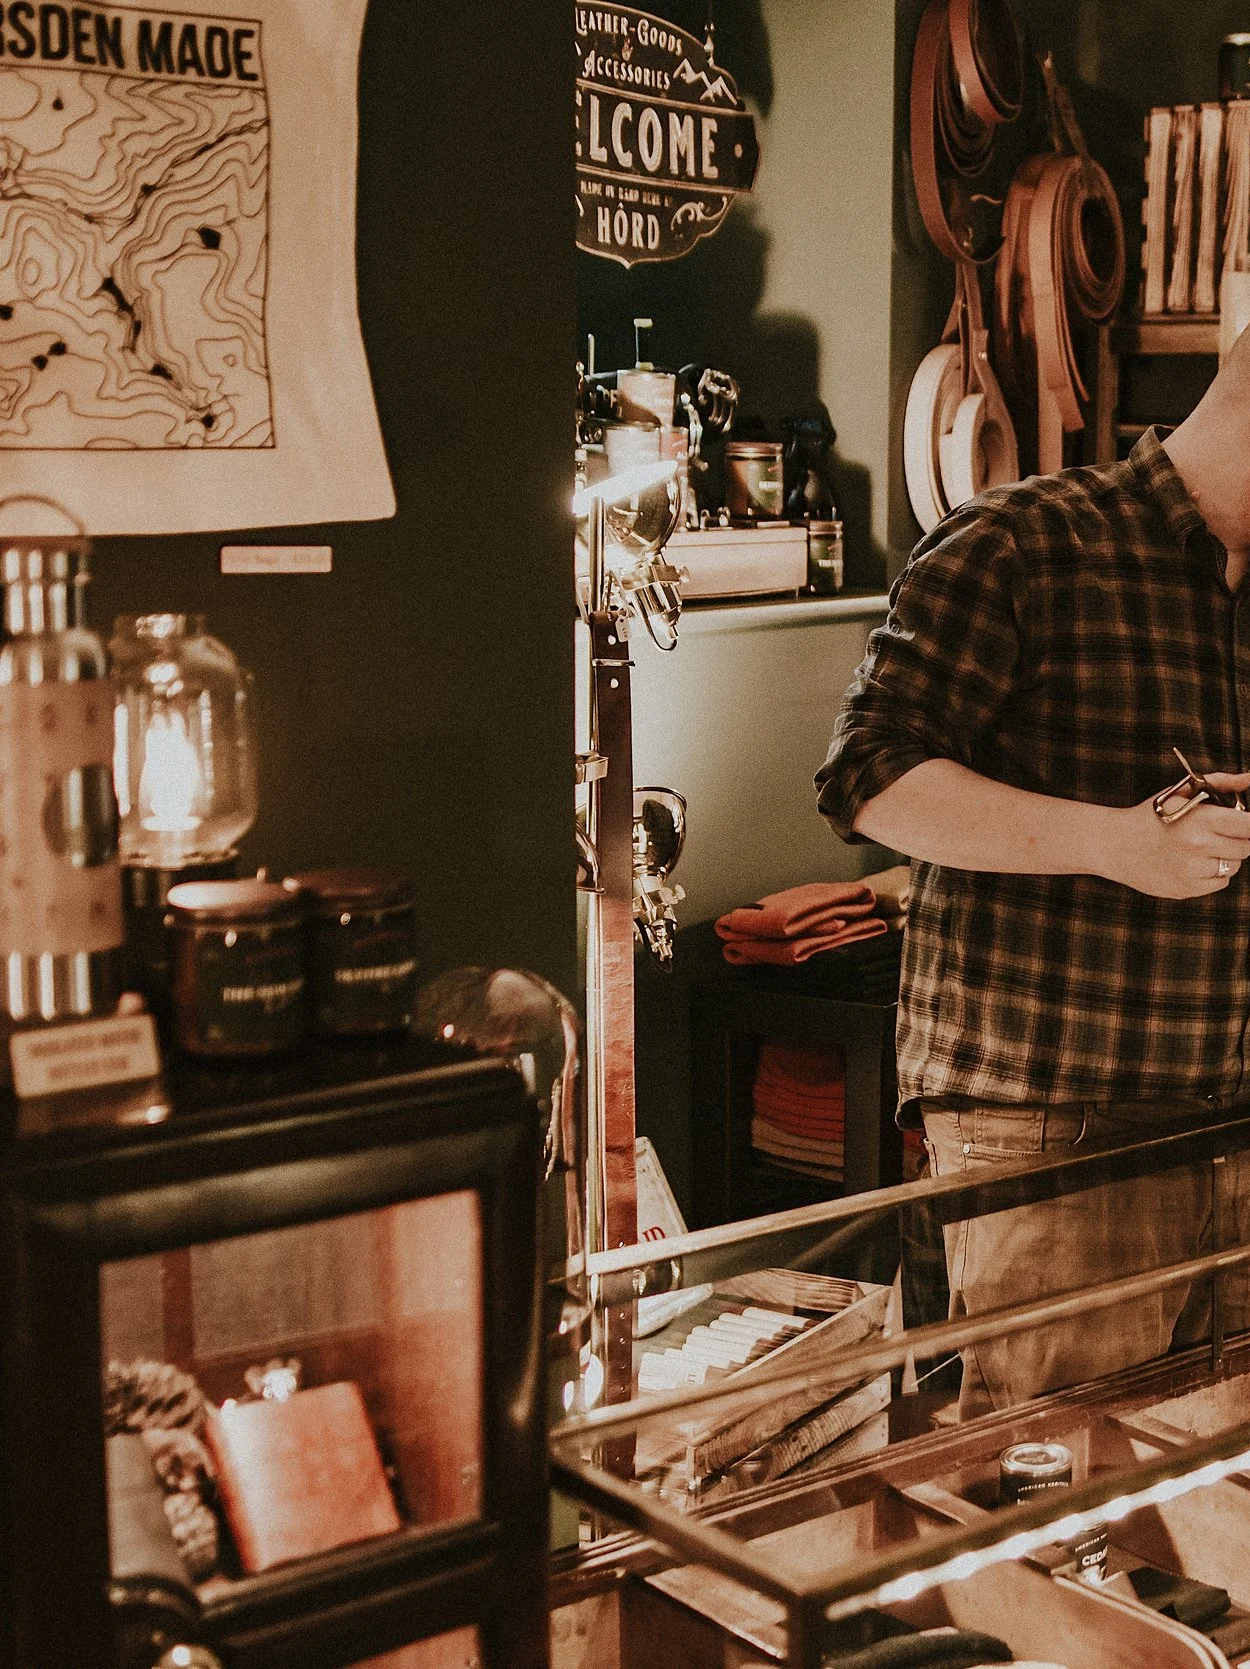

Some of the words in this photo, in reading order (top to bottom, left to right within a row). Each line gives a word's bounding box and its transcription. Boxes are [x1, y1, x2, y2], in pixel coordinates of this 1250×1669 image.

[0, 1, 125, 69] SDEN
[137, 19, 259, 82] MADE
[582, 49, 671, 90] ACCESSORIES
[597, 202, 661, 250] HÔRD
